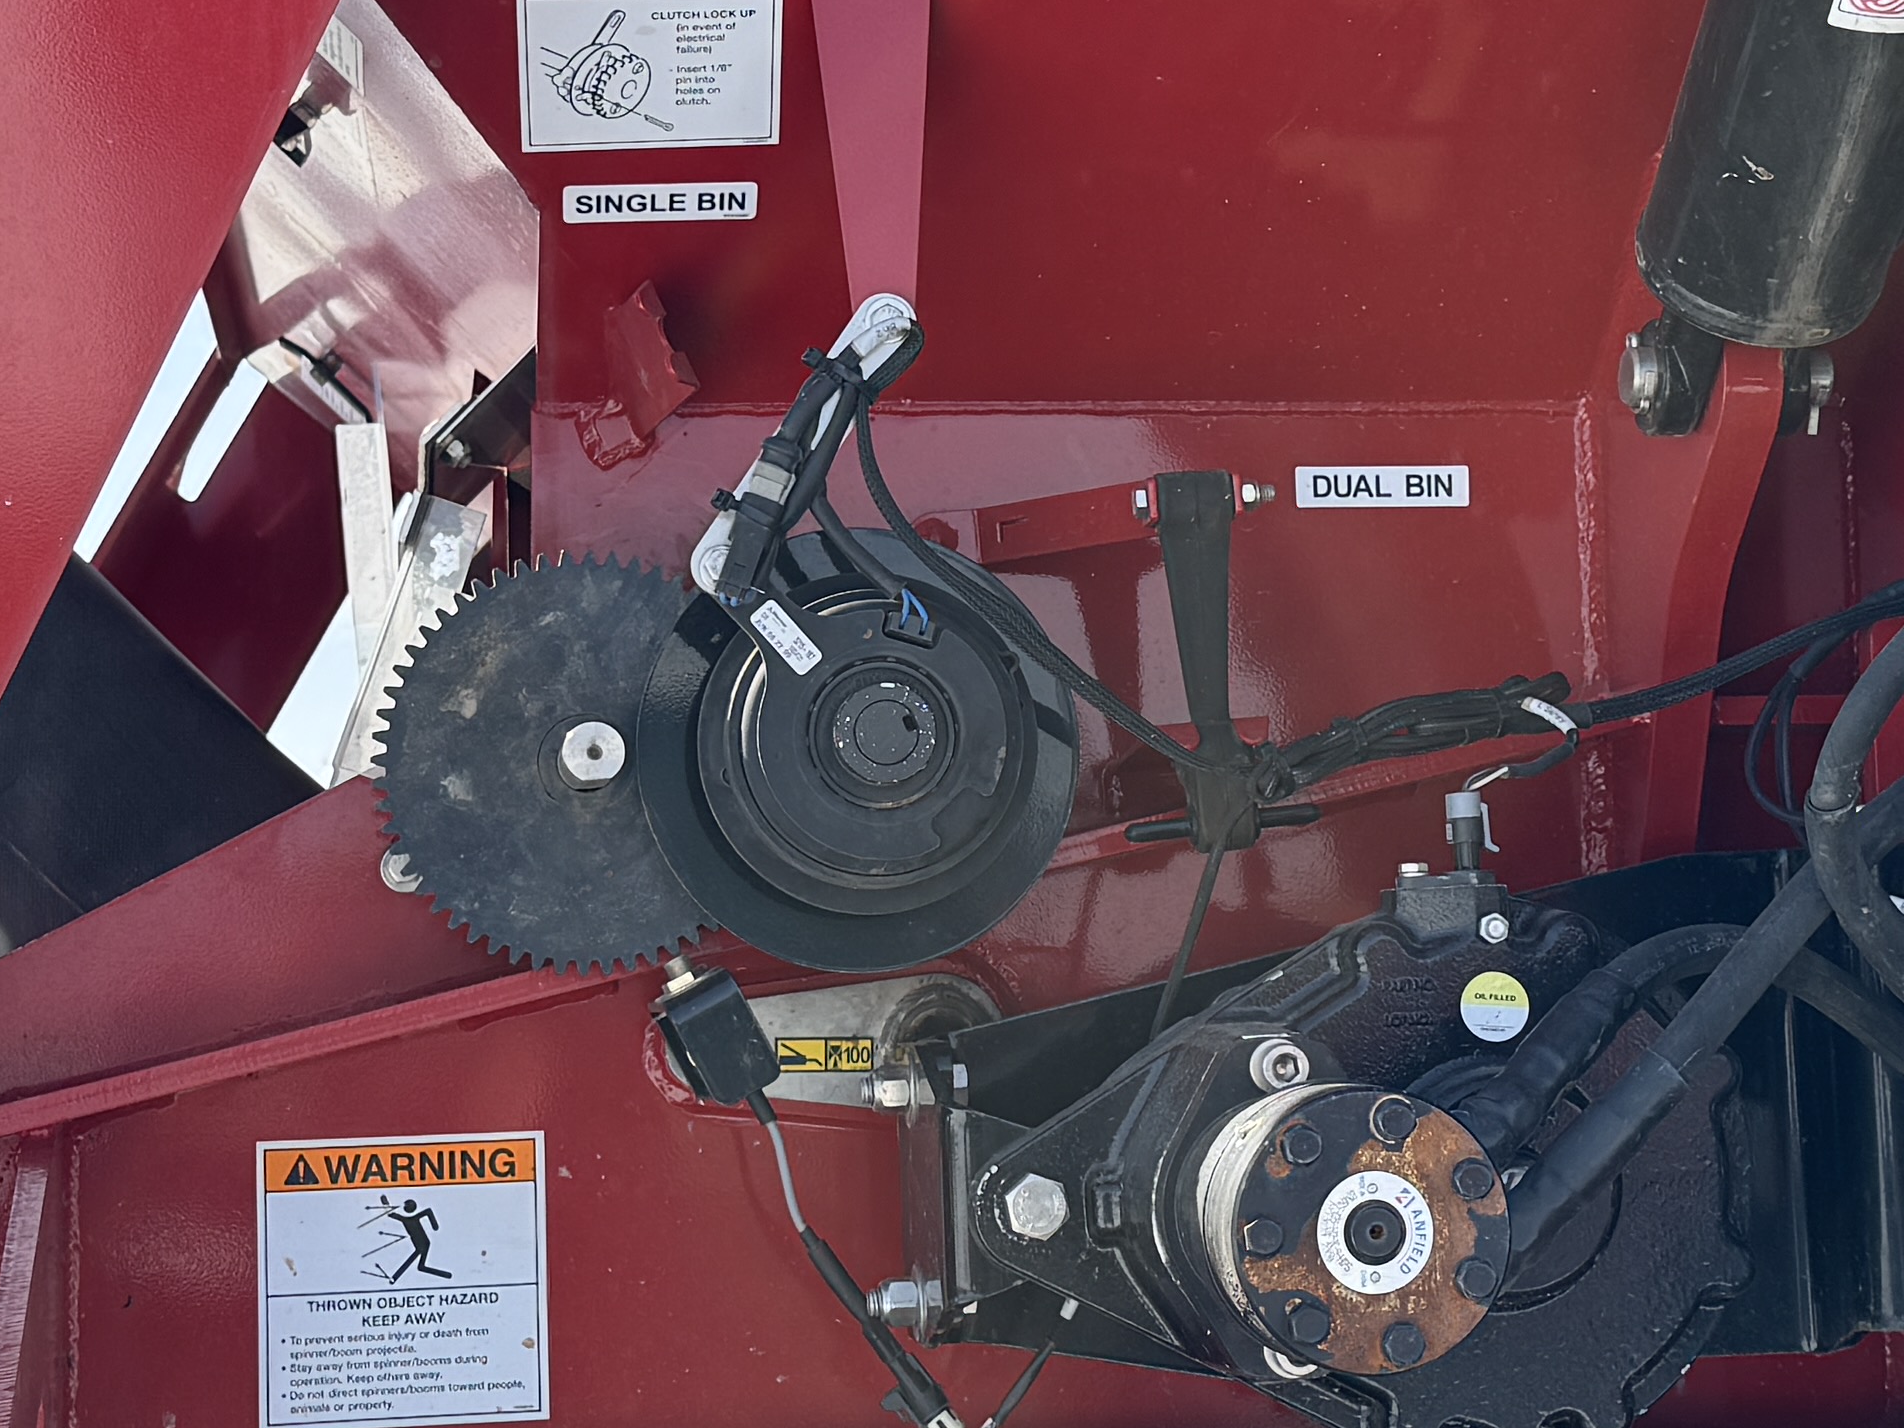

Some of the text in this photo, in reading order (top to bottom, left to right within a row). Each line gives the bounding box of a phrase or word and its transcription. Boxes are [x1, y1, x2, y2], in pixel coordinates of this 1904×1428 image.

[651, 10, 756, 20] CLUTCH LOCK UP
[676, 22, 736, 32] (in event of
[676, 34, 725, 42] electrical
[676, 45, 712, 54] failure)
[677, 65, 707, 73] Insert
[675, 87, 704, 95] holes
[675, 98, 711, 106] clutch.
[575, 192, 747, 214] SINGLE BIN
[1312, 473, 1453, 498] DUAL BIN
[1489, 993, 1516, 1002] FILLED
[843, 1046, 870, 1064] 100
[323, 1147, 517, 1185] WARNING
[1399, 1208, 1427, 1275] ANFIELD
[307, 1292, 499, 1313] THROWN OBJECT HAZARD
[362, 1312, 446, 1327] KEEP AWAY
[290, 1327, 489, 1346] To prevent serious injury or death from
[290, 1363, 313, 1374] Stay
[316, 1363, 343, 1373] away
[347, 1359, 371, 1370] from
[455, 1354, 488, 1365] during
[347, 1374, 374, 1385] Keep
[377, 1371, 410, 1382] others
[413, 1370, 443, 1381] away.
[290, 1390, 305, 1401] Do
[308, 1389, 324, 1399] not
[329, 1388, 358, 1398] direct
[448, 1382, 484, 1392] toward
[290, 1399, 394, 1415] animals or property.
